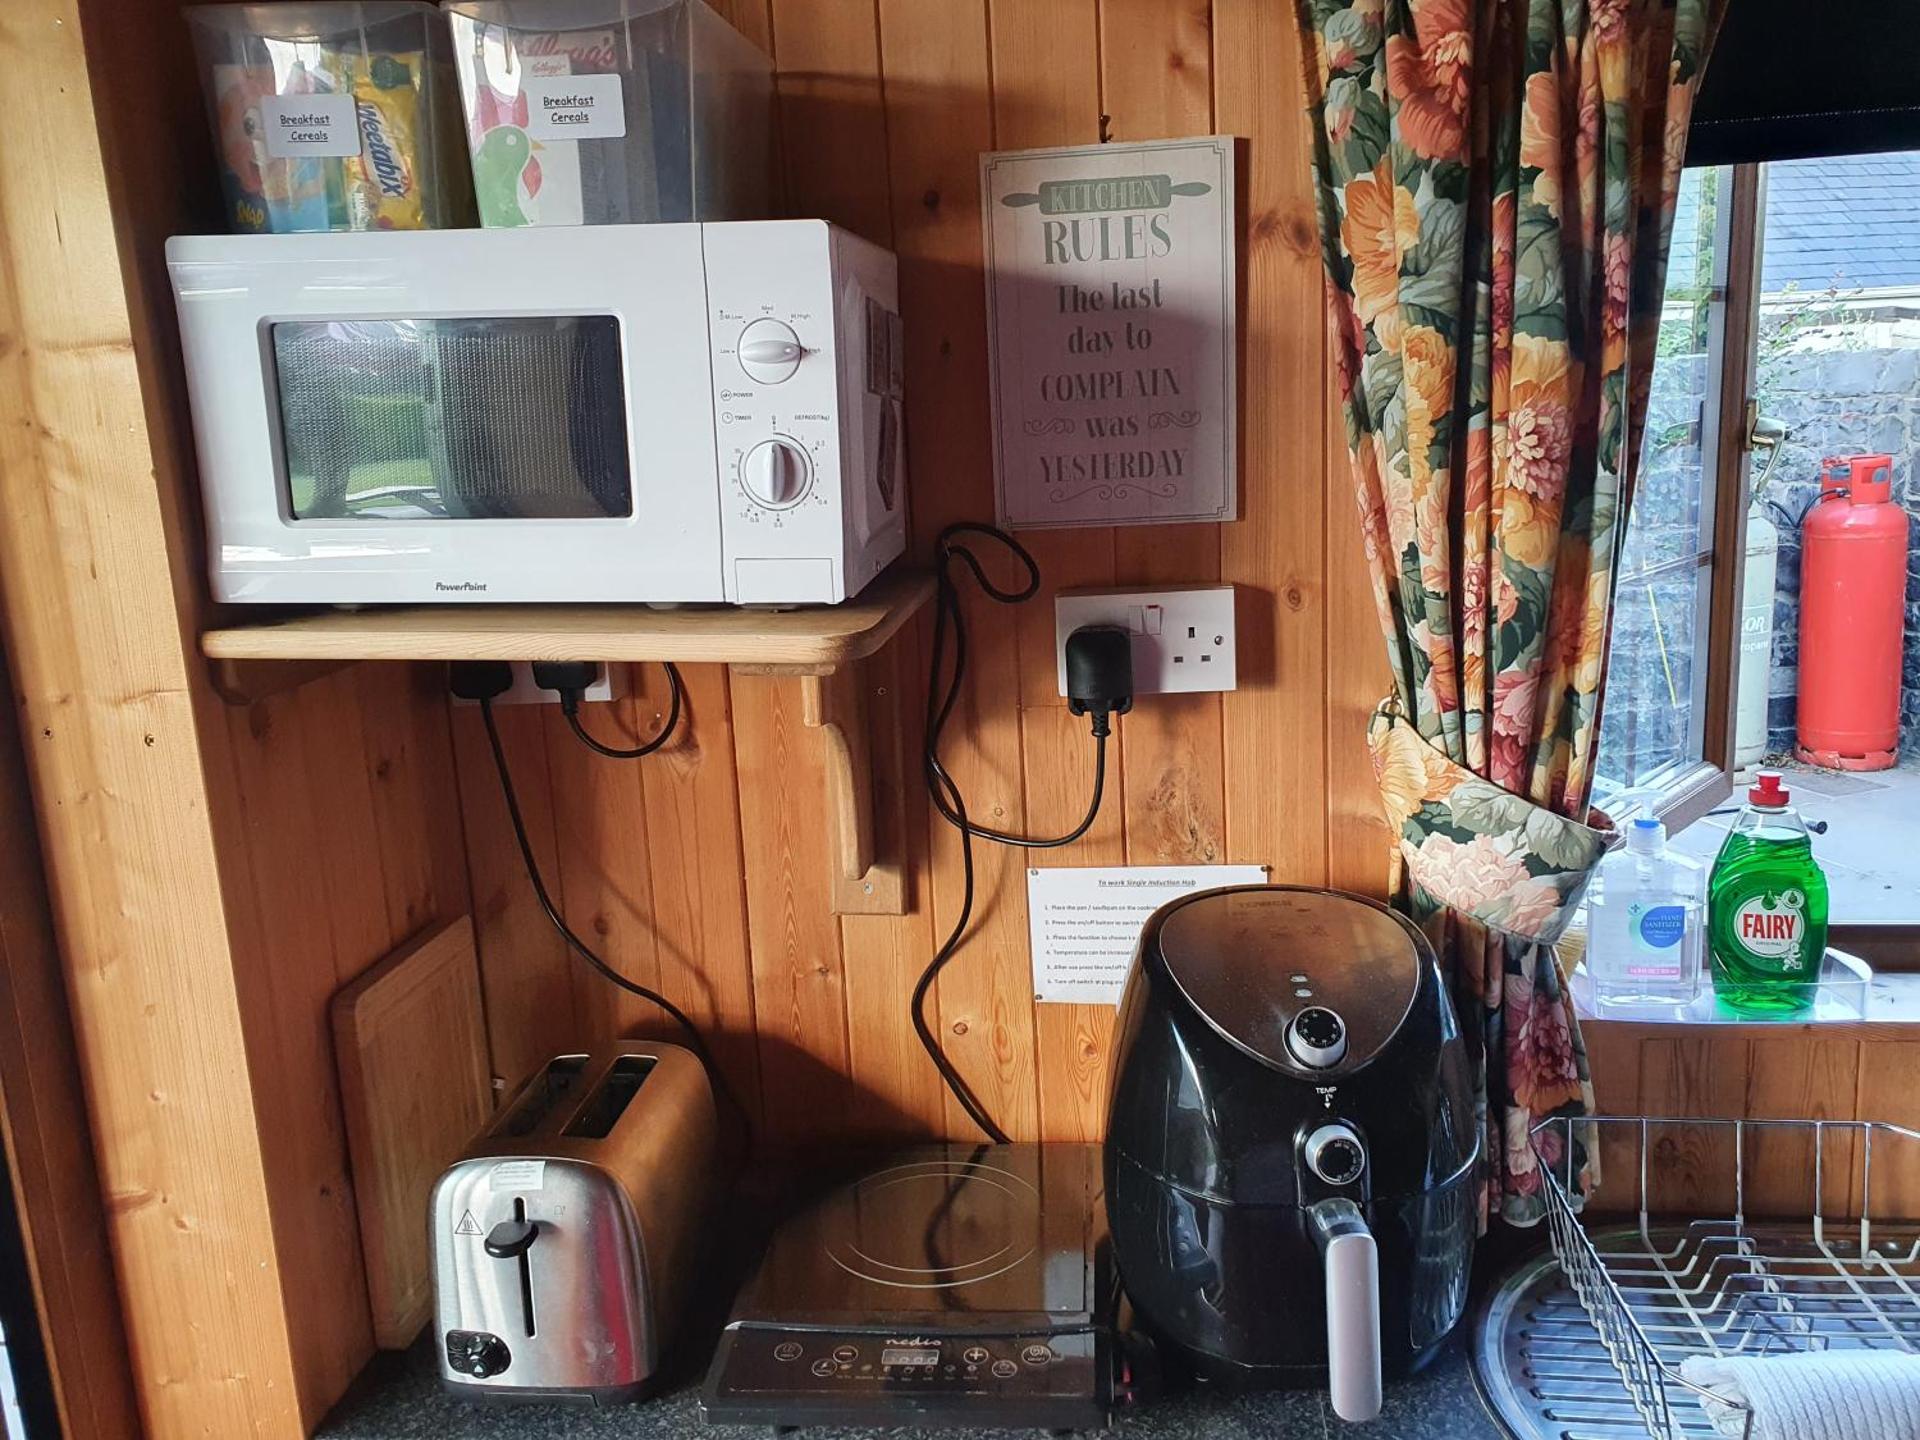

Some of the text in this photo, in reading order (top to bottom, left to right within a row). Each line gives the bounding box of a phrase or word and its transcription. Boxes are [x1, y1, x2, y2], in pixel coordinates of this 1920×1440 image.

[543, 95, 594, 109] Breakfast
[279, 114, 331, 127] Breakfast
[551, 111, 590, 124] Cereals
[287, 131, 329, 142] Cereals
[357, 103, 405, 199] Weetabix
[1050, 179, 1161, 213] KITCHEN
[1042, 213, 1172, 265] RULES
[1055, 278, 1163, 314] The last
[1067, 322, 1152, 356] day to
[1040, 368, 1181, 402] COMPLAIN
[1085, 415, 1139, 438] was
[1040, 449, 1187, 483] YESTERDAY
[435, 581, 487, 591] PowerPoint
[1108, 879, 1125, 887] work
[1743, 914, 1796, 940] FAIRY
[1315, 1086, 1337, 1095] TEMP
